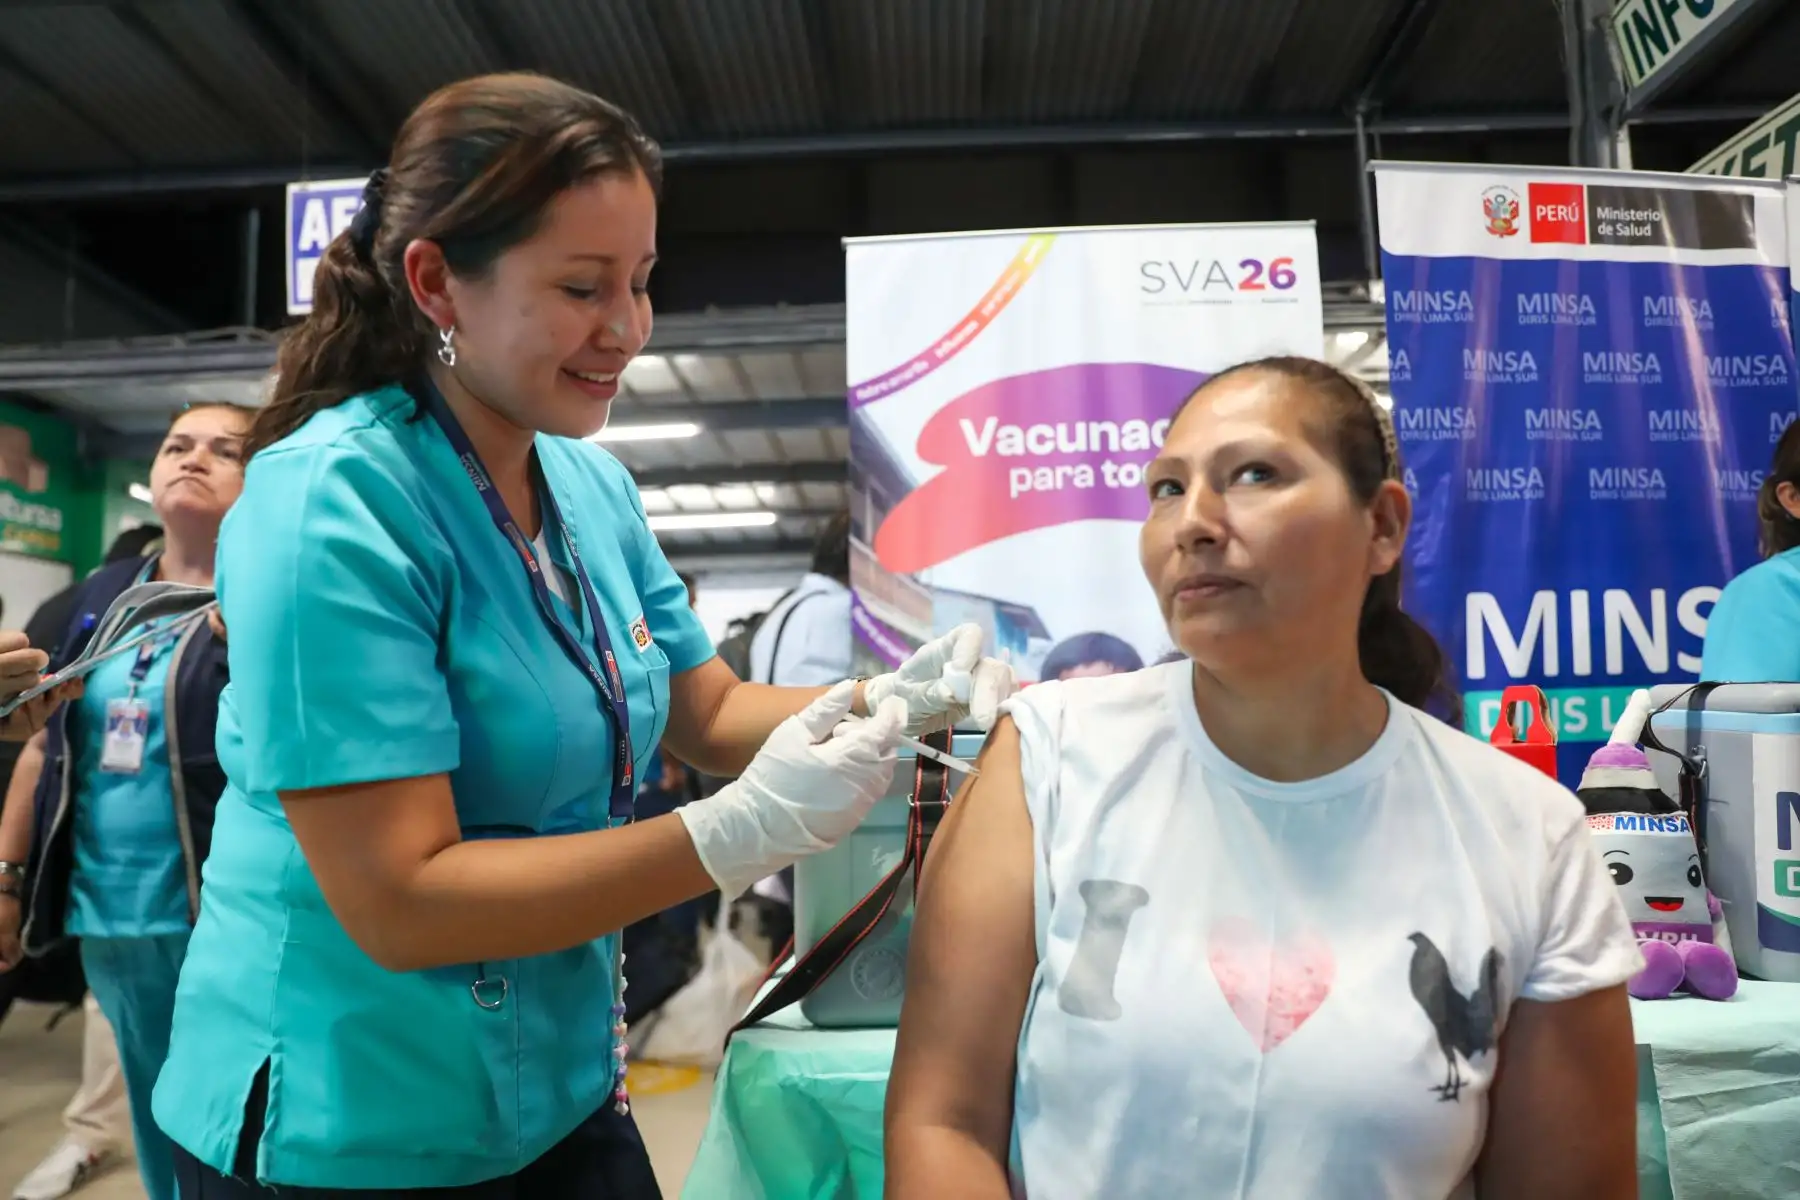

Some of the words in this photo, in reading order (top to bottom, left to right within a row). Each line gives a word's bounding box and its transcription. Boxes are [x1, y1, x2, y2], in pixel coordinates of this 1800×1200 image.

[1536, 202, 1579, 222] PERÚ
[1597, 207, 1661, 221] Ministerio
[1598, 224, 1613, 235] de
[1616, 223, 1652, 237] Salud
[1140, 256, 1297, 294] SVA26
[1393, 290, 1474, 312] MINSA
[1517, 293, 1596, 315] MINSA
[1643, 296, 1714, 320] MINSA
[1423, 312, 1451, 323] LIMA
[1454, 312, 1475, 323] SUR
[1575, 315, 1597, 326] SUR
[1463, 348, 1538, 373] MINSA
[1583, 352, 1661, 374] MINSA
[1704, 354, 1788, 376] MINSA
[1515, 372, 1539, 384] SUR
[1641, 373, 1662, 384] SUR
[1730, 377, 1760, 388] LIMA
[1763, 375, 1788, 387] SUR
[1400, 407, 1476, 430] MINSA
[1525, 408, 1602, 431] MINSA
[1649, 409, 1720, 432] MINSA
[1432, 429, 1460, 440] LIMA
[1581, 431, 1602, 441] SUR
[1009, 462, 1095, 499] para
[1101, 459, 1152, 488] to
[1467, 467, 1544, 490] MINSA
[1589, 468, 1666, 489] MINSA
[1479, 696, 1589, 738] DIIS
[1614, 815, 1691, 833] MINSA
